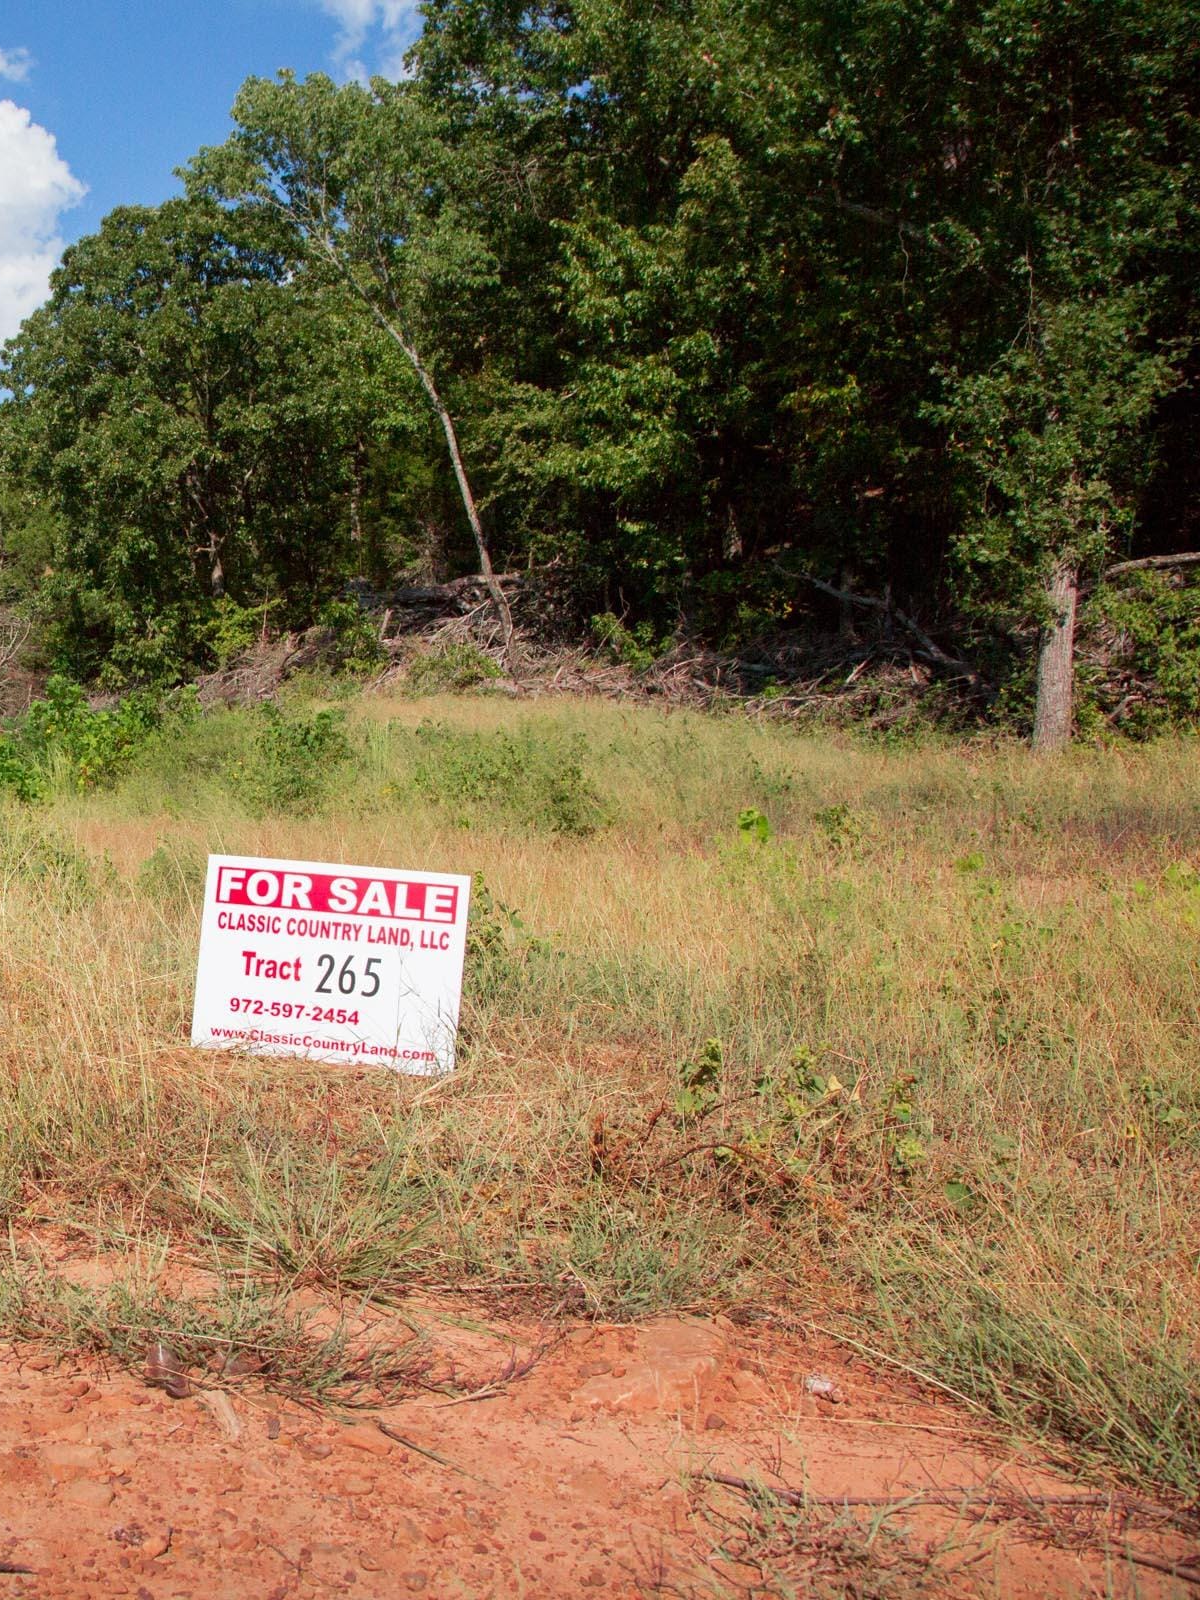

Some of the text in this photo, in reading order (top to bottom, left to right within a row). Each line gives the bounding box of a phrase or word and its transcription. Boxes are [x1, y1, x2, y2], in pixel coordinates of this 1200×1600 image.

[219, 869, 455, 922] FOR SALE
[218, 911, 451, 952] CLASSIC COUNTRY LAND, LLC
[242, 951, 382, 997] Tract 265
[229, 998, 360, 1026] 972-597-2454
[210, 1026, 436, 1062] www.ClassicCountryLand.com
